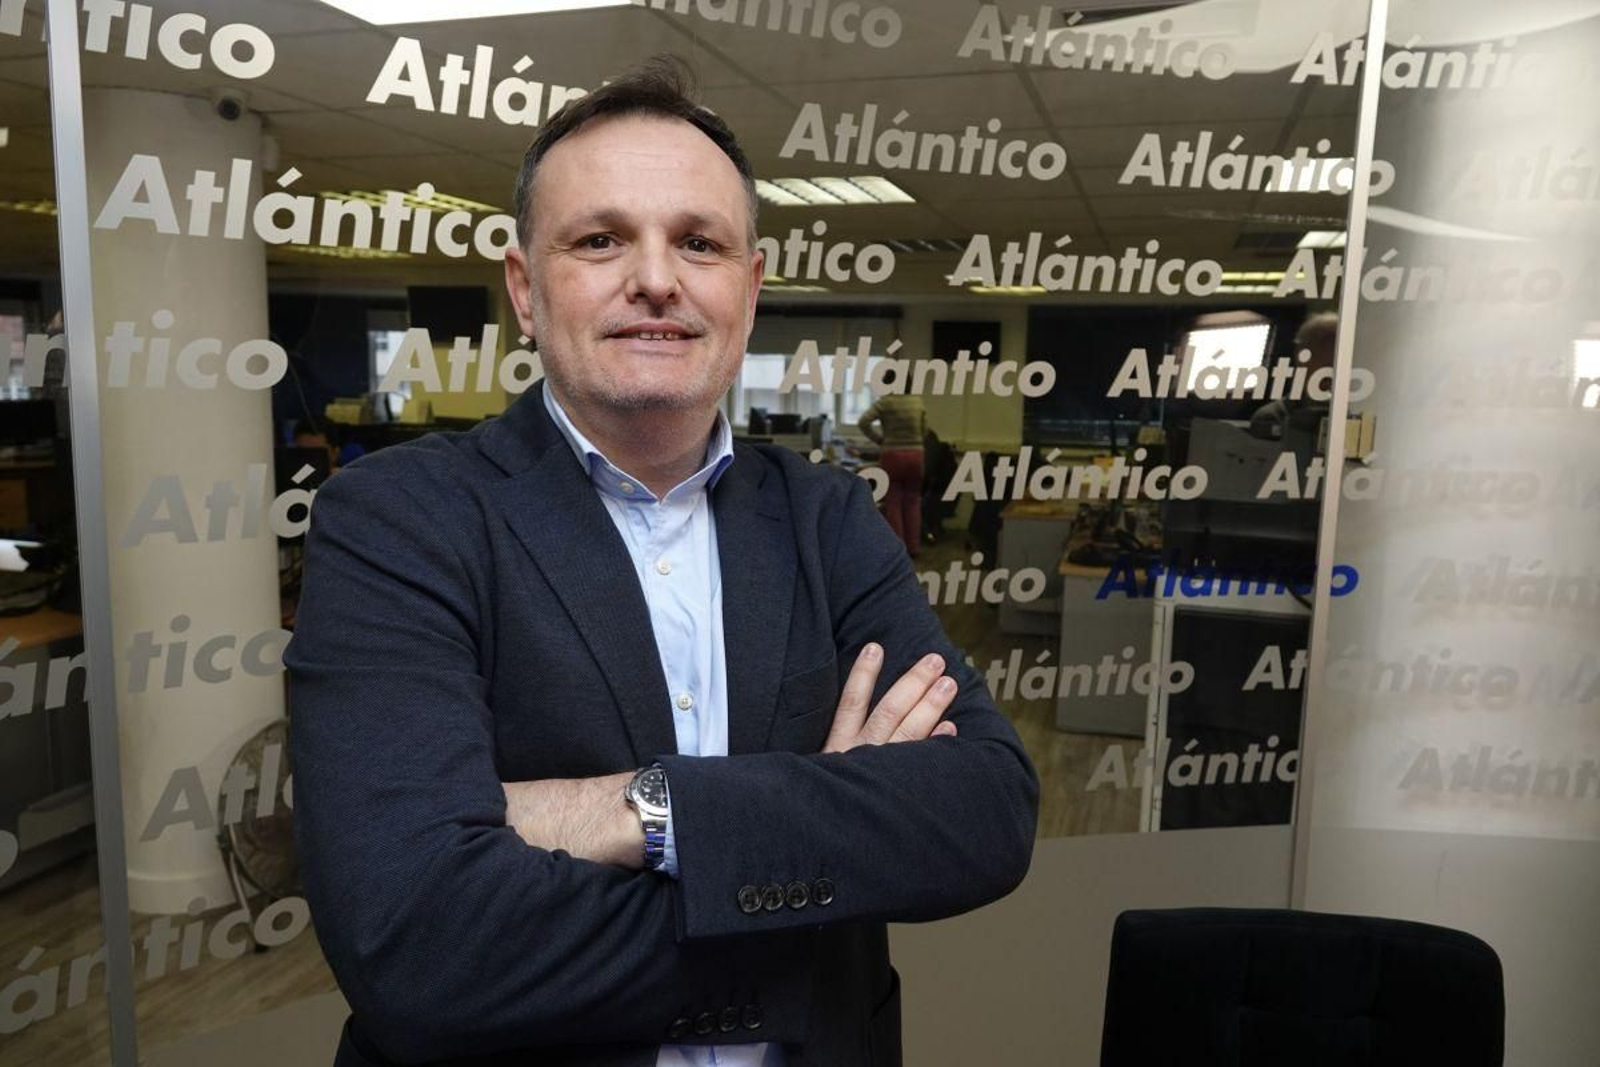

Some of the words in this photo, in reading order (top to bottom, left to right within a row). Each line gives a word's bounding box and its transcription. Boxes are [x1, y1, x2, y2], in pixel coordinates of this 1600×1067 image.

[957, 4, 1239, 80] Atlántico
[779, 102, 1067, 181] Atlántico
[1118, 131, 1396, 197] Atlántico
[93, 154, 517, 261] Atlántico
[947, 232, 1223, 297] Atlántico
[0, 309, 289, 390] ntico
[780, 336, 1056, 398] Atlántico
[1107, 347, 1376, 401] Atlántico
[941, 446, 1208, 501] Atlántico
[964, 645, 1195, 701] tlántico
[1241, 645, 1520, 693] Atántico
